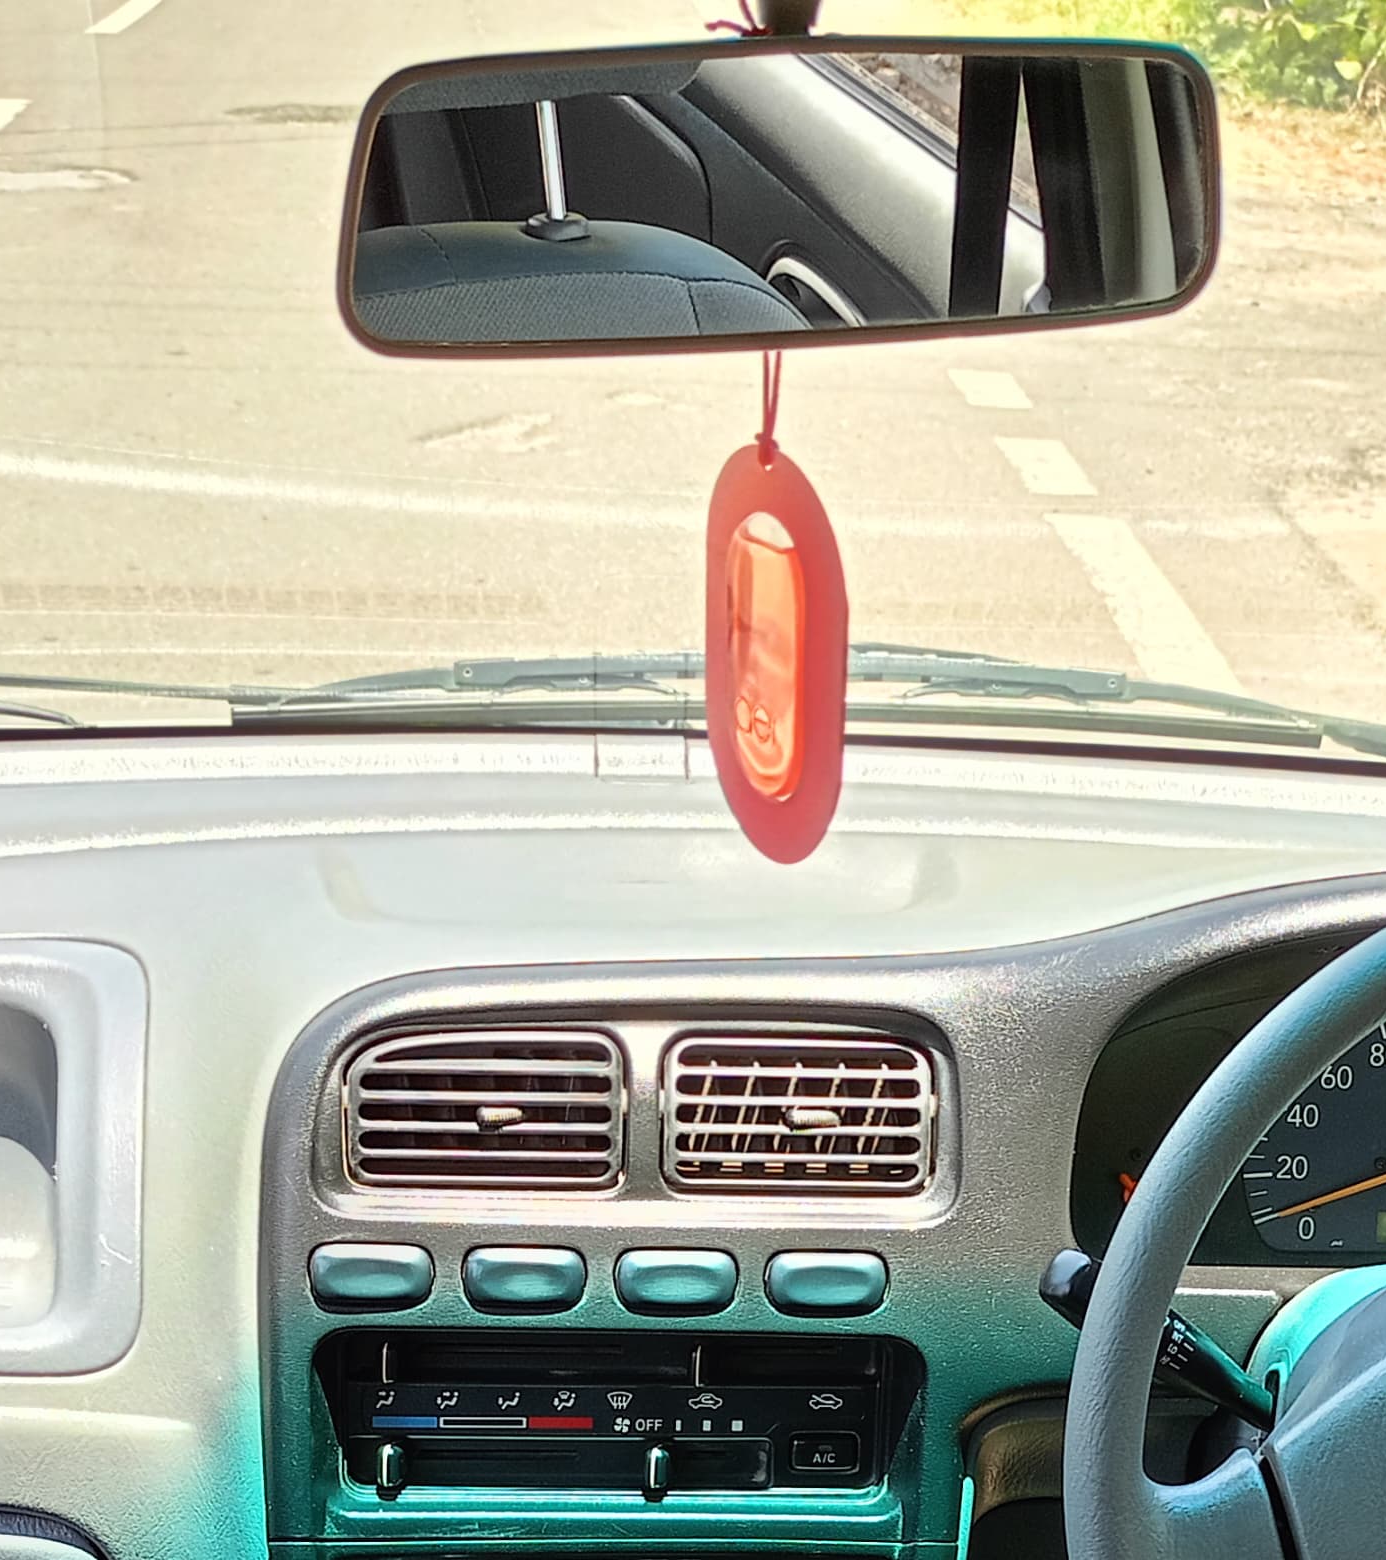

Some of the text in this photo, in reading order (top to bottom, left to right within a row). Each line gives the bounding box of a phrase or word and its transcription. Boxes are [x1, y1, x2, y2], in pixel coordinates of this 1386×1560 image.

[1320, 1065, 1353, 1090] 60
[1286, 1104, 1319, 1128] 40
[1276, 1155, 1309, 1180] 20
[1298, 1216, 1315, 1240] 0
[635, 1418, 663, 1432] OFF
[812, 1453, 836, 1464] A/C
